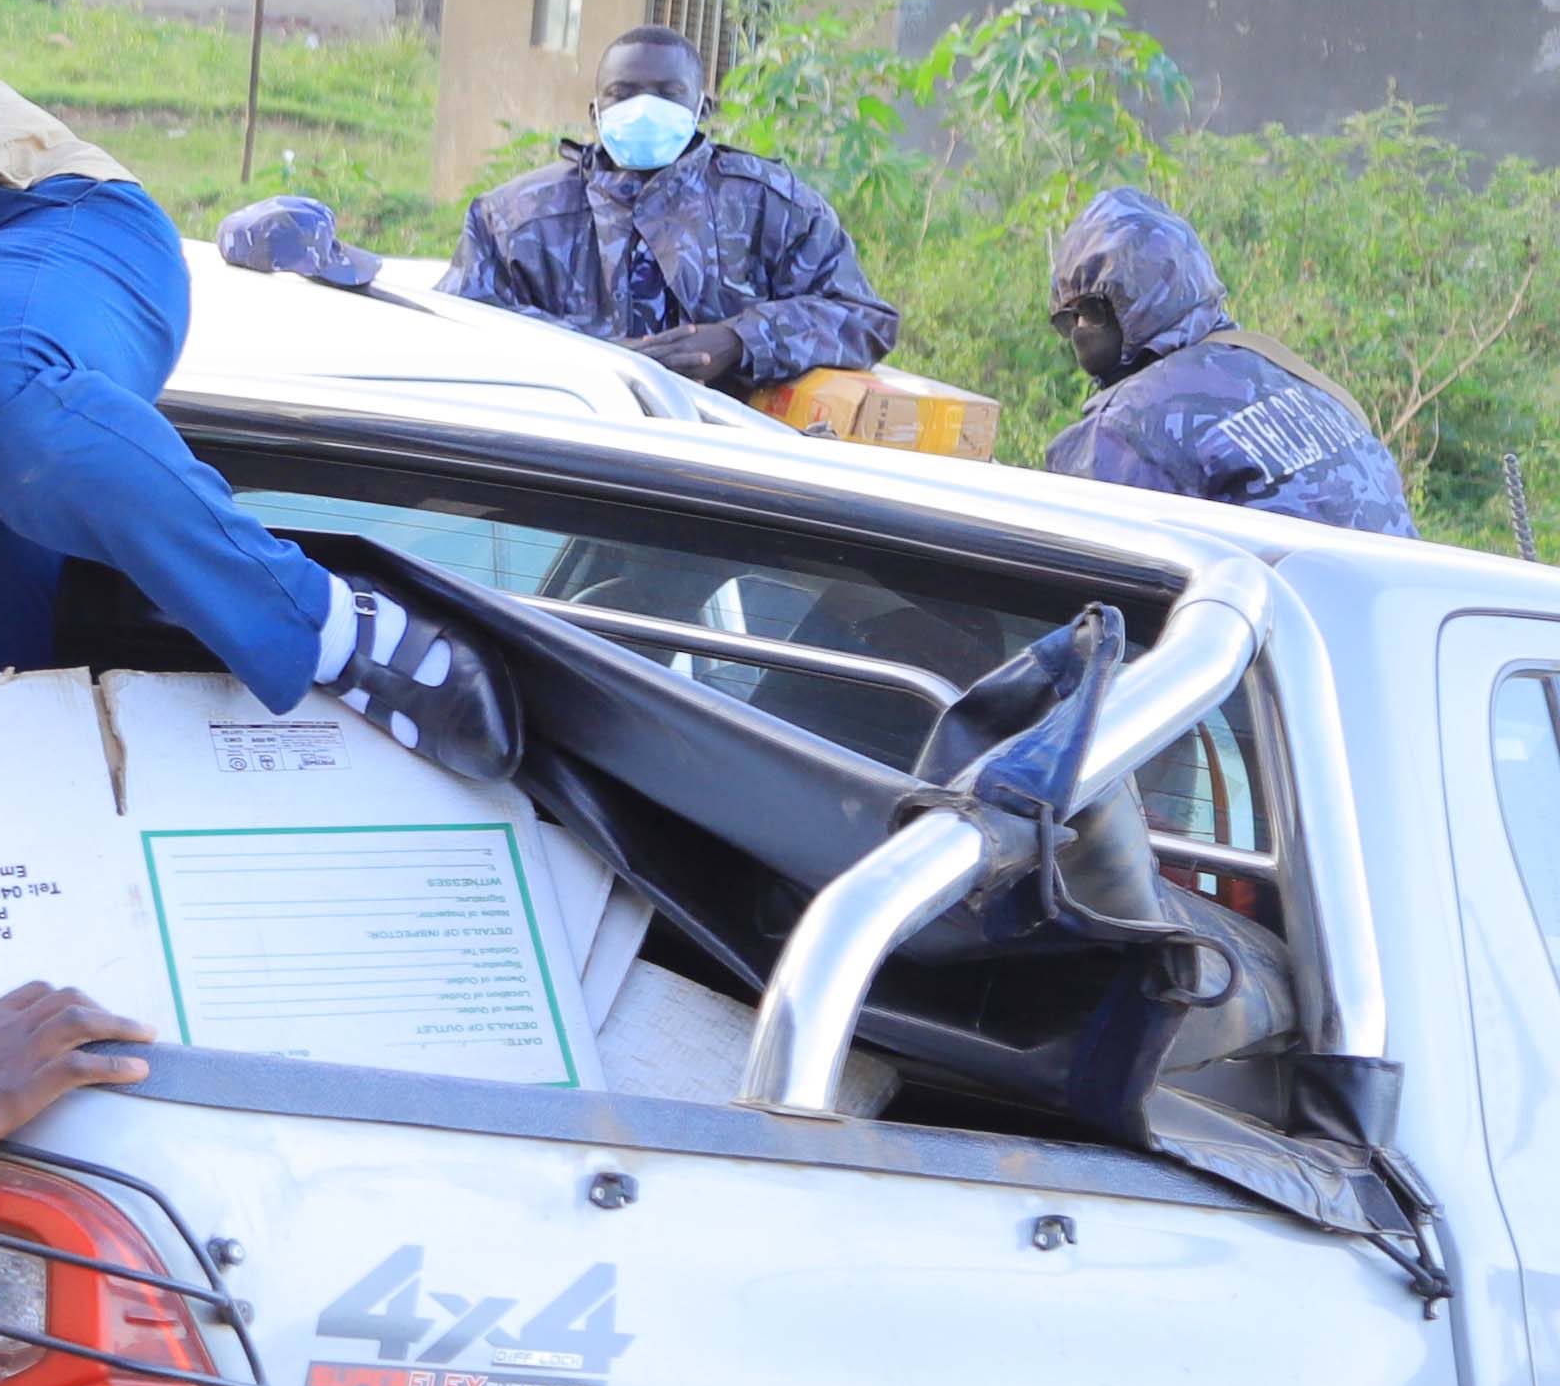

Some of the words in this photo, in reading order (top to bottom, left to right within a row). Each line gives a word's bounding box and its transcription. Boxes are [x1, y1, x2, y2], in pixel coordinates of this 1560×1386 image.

[427, 877, 501, 887] WITNESSES
[28, 881, 60, 896] Tel:
[462, 926, 513, 935] DETAILS
[416, 1024, 463, 1034] OUTLET
[488, 1021, 537, 1031] DETAILS
[316, 1244, 635, 1374] 4x4
[540, 1353, 583, 1368] LOCK
